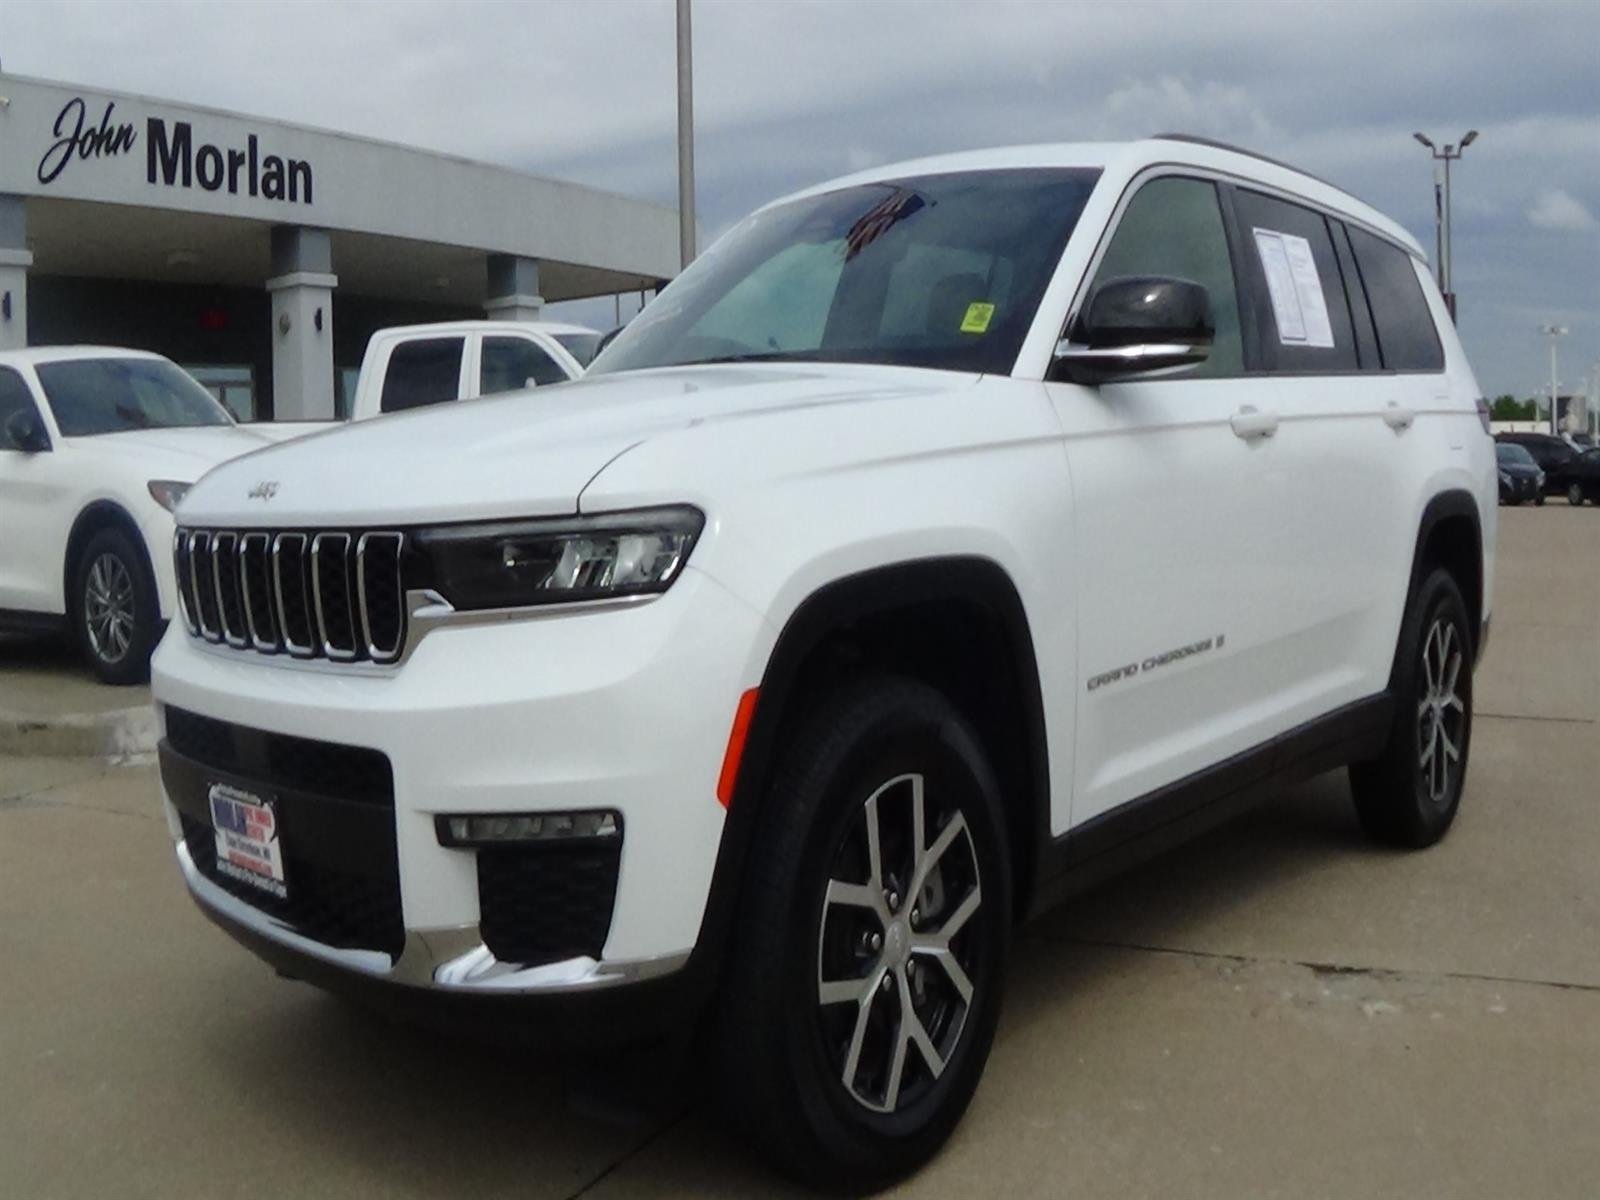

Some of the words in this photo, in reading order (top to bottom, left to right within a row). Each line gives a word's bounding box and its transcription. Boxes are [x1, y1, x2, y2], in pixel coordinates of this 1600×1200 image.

[37, 97, 138, 184] John
[147, 117, 313, 204] Morlan
[1087, 663, 1139, 691] GRAND
